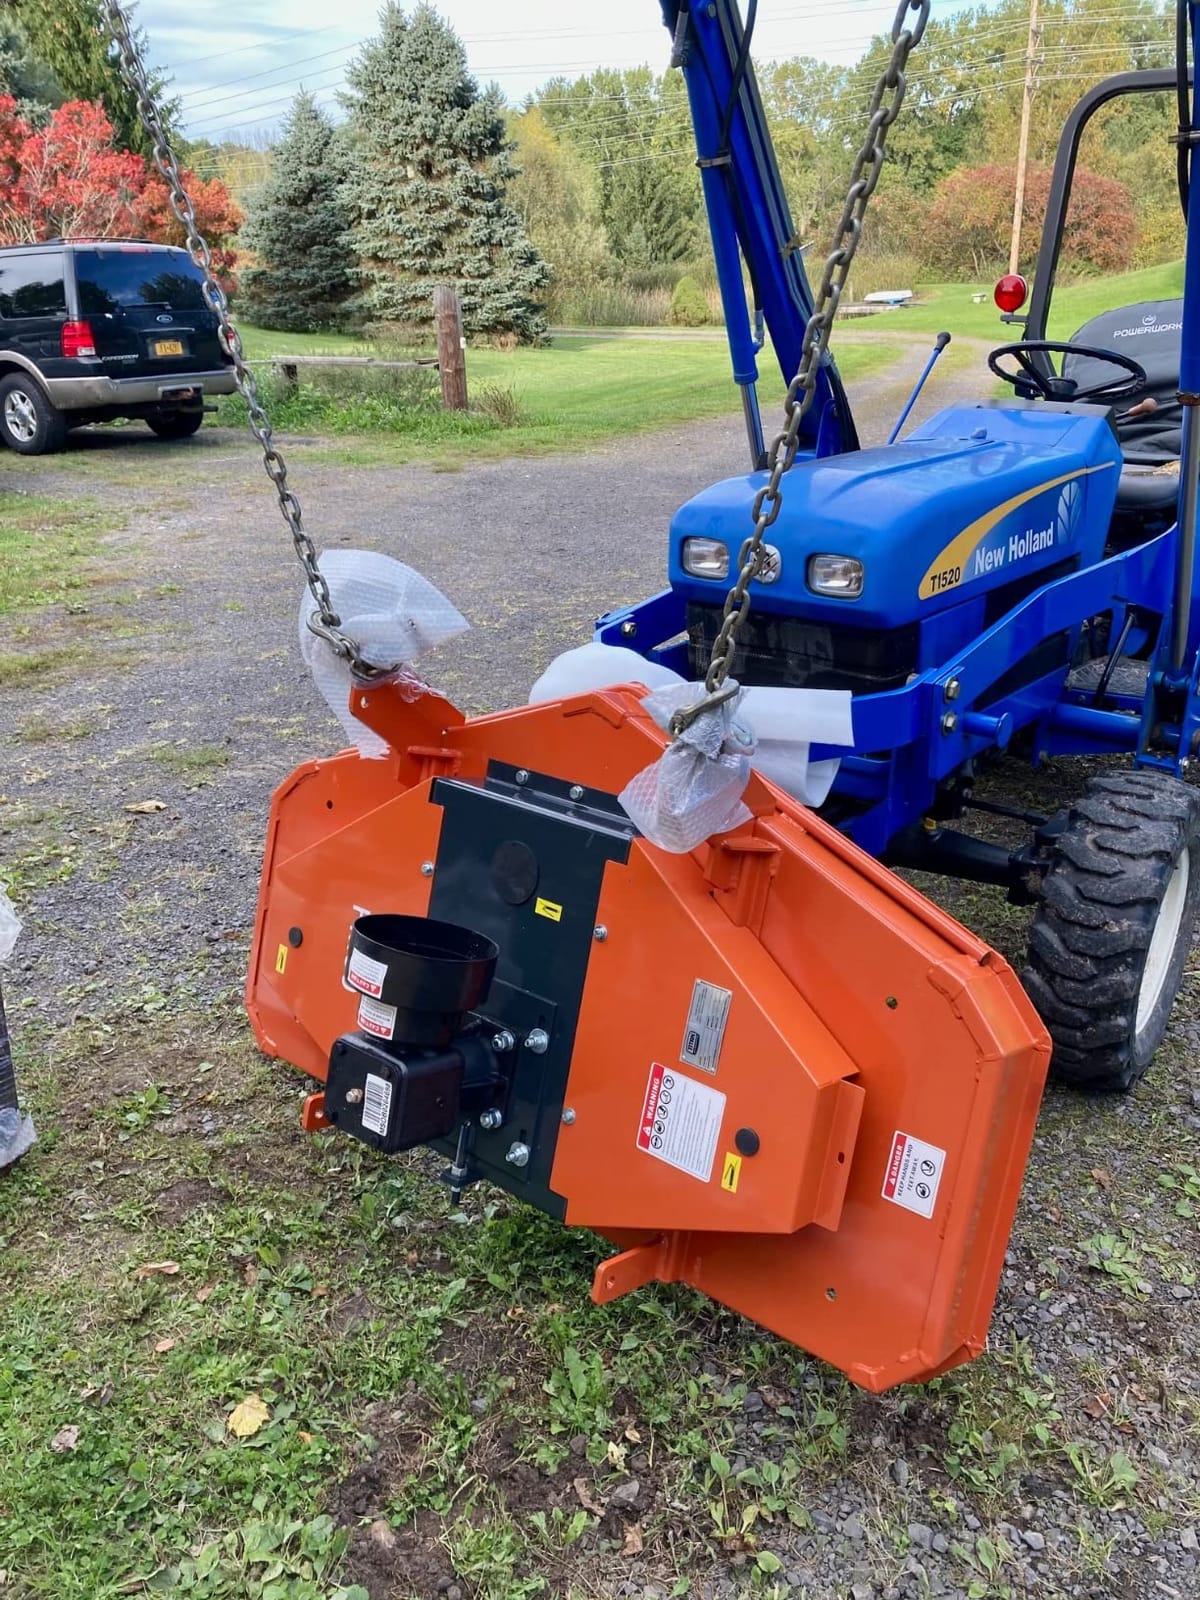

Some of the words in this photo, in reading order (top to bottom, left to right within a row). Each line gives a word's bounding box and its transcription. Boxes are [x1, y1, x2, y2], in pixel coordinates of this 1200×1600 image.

[974, 546, 1005, 575] New
[1009, 521, 1054, 562] Holland
[930, 566, 961, 592] T1520
[646, 1077, 660, 1120] WARNING
[890, 1144, 903, 1177] DANGER
